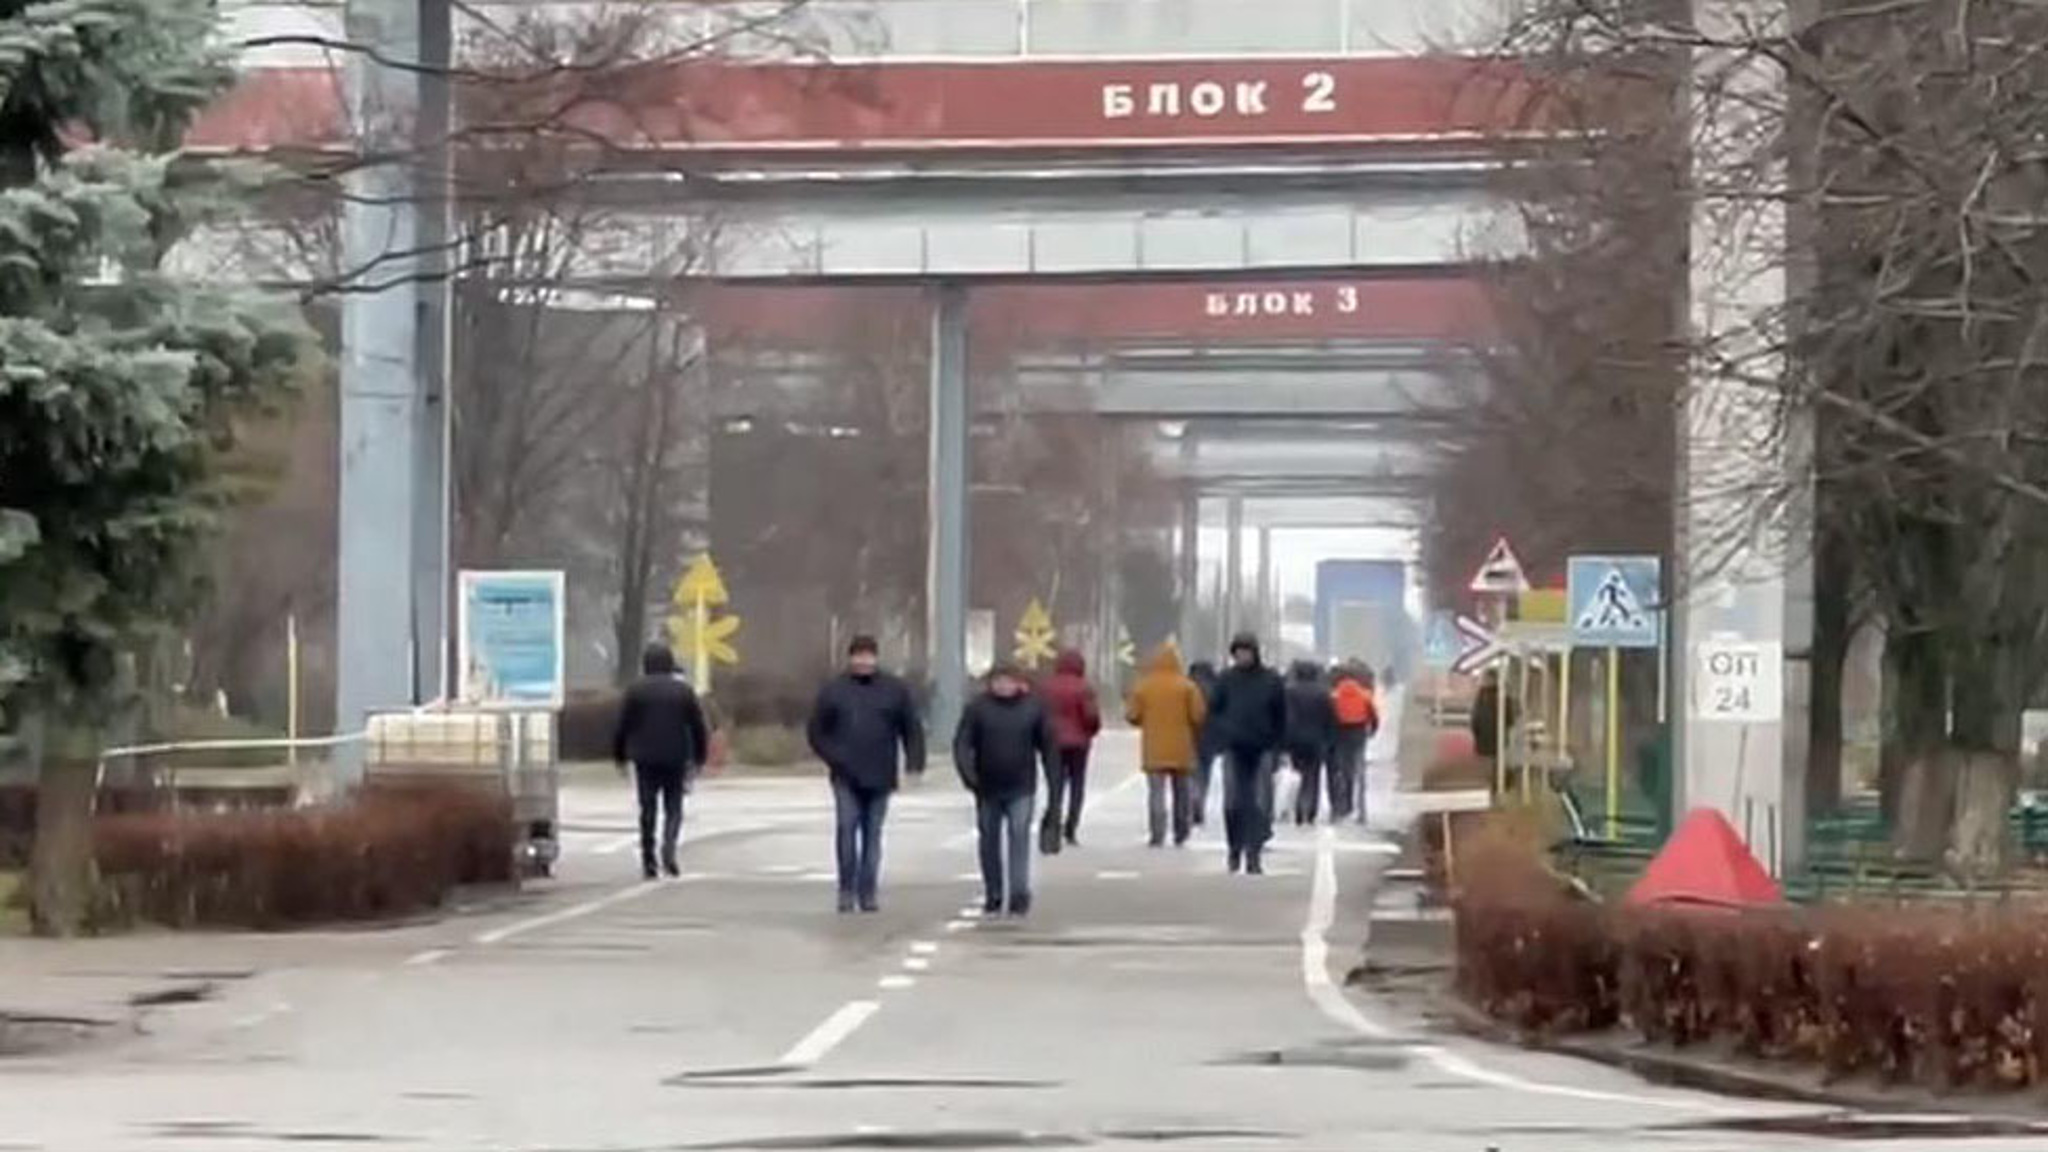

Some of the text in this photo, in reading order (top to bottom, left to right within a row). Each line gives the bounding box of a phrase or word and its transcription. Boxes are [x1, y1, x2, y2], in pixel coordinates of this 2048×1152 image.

[1103, 72, 1337, 118] БЛОК 2
[1206, 286, 1358, 316] БЛОК 3
[1715, 686, 1750, 711] 24
